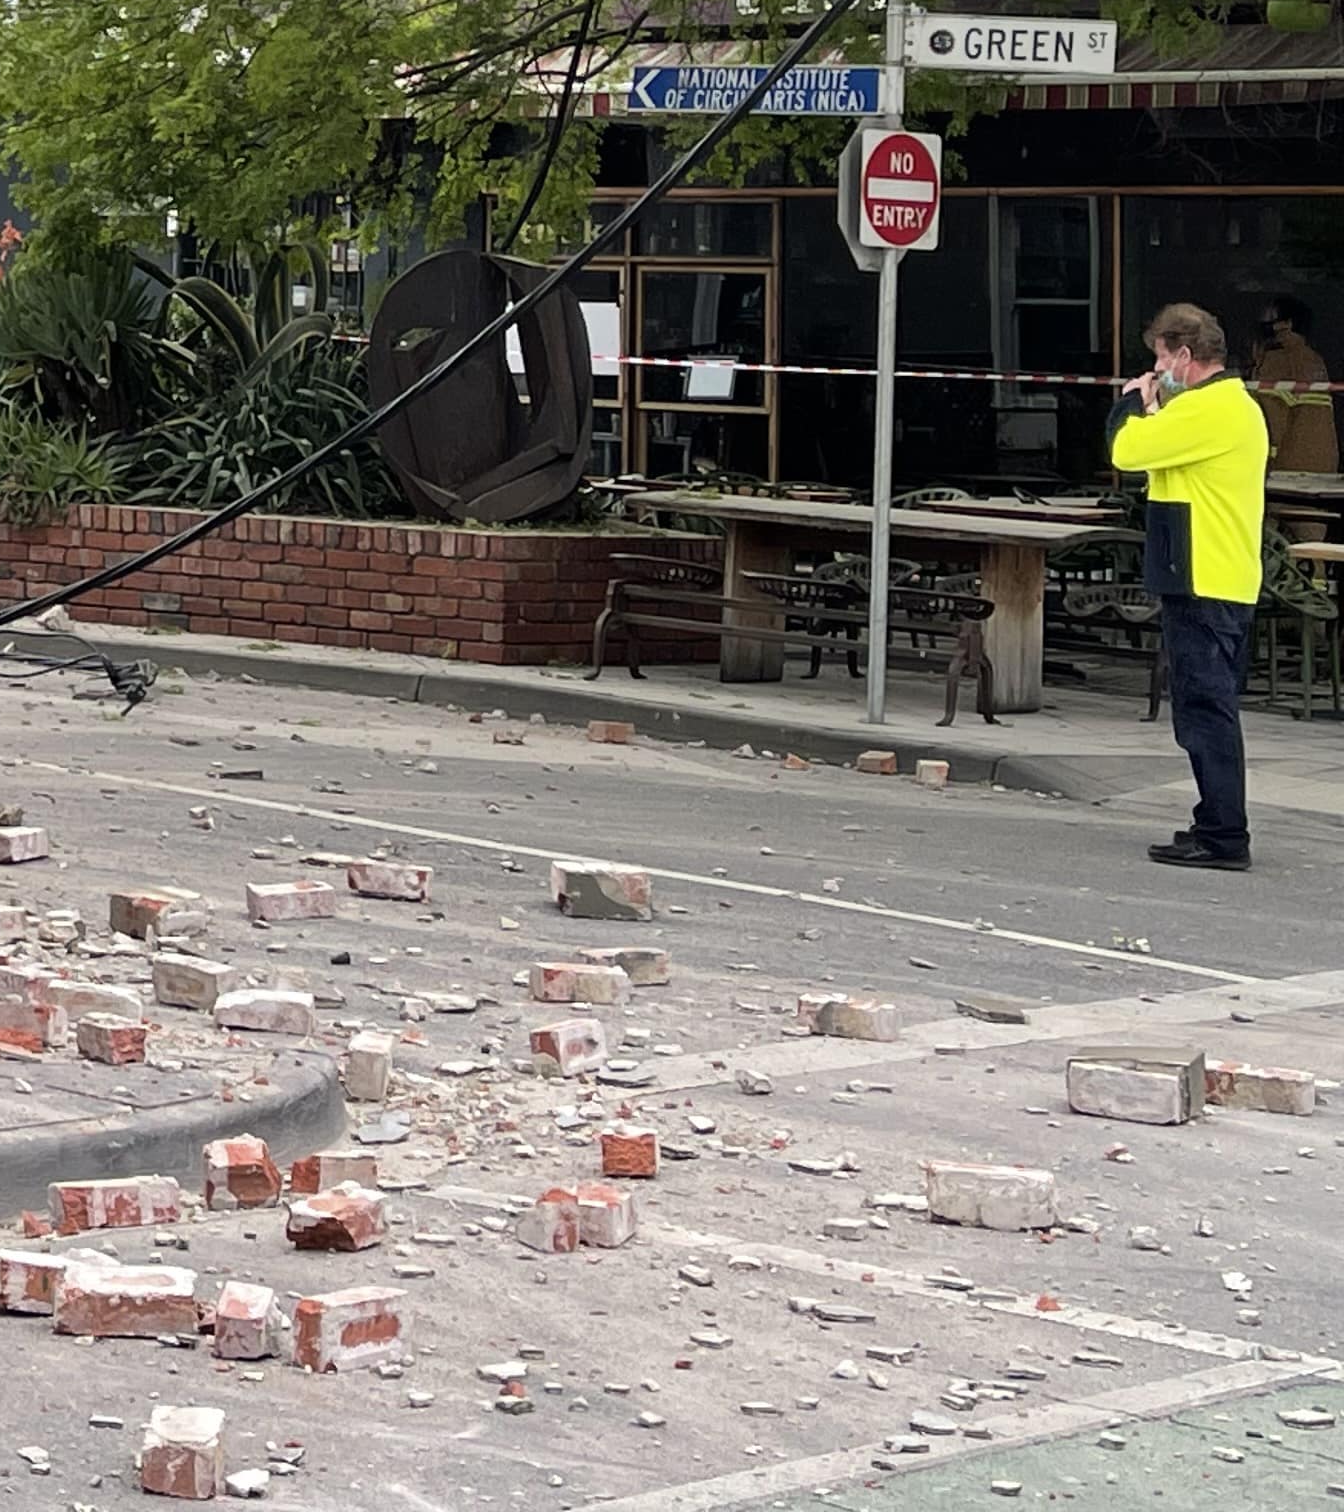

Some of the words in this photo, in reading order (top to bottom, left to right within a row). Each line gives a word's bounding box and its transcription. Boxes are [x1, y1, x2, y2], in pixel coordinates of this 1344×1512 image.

[964, 27, 1074, 63] GREEN
[1087, 31, 1108, 53] ST
[678, 68, 755, 89] NATIONAL
[665, 88, 687, 110] OF
[693, 89, 750, 110] CIRCU
[761, 90, 806, 111] ARTS
[811, 90, 865, 112] (NICA)
[890, 151, 914, 174] NO
[873, 204, 928, 230] ENTRY
